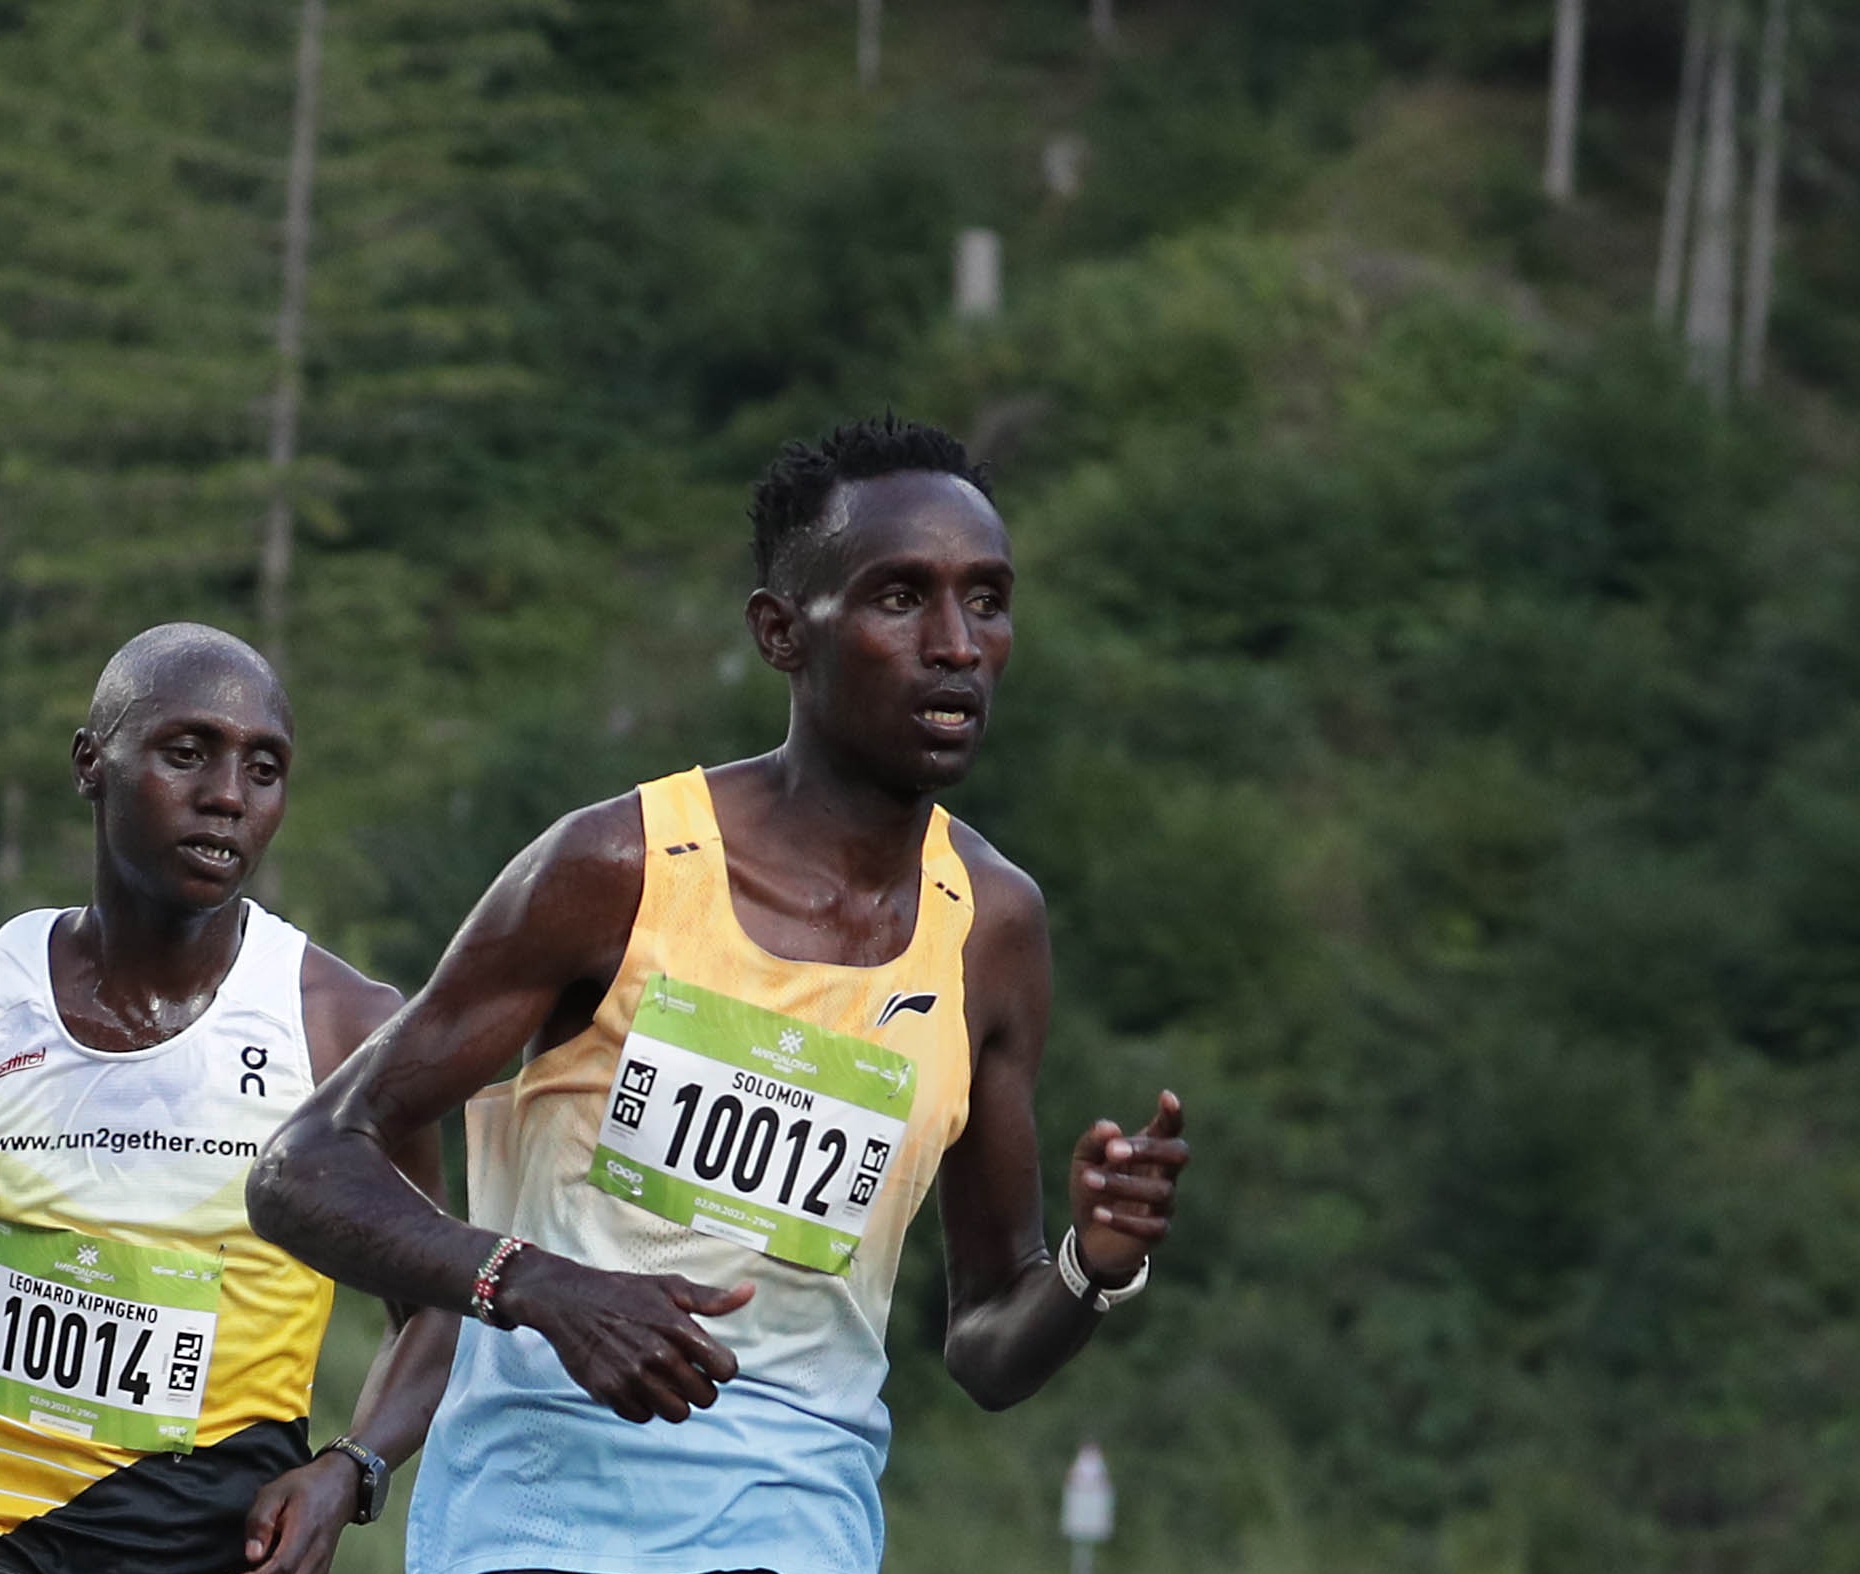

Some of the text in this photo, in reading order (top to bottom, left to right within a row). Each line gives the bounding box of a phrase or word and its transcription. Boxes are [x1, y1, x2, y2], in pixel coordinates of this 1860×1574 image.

[732, 1071, 816, 1113] SOLOMON
[606, 1159, 644, 1184] coop
[664, 1082, 848, 1218] 10012
[8, 1272, 159, 1325] LEONARD KIPNGENO
[1, 1296, 154, 1406] 10014
